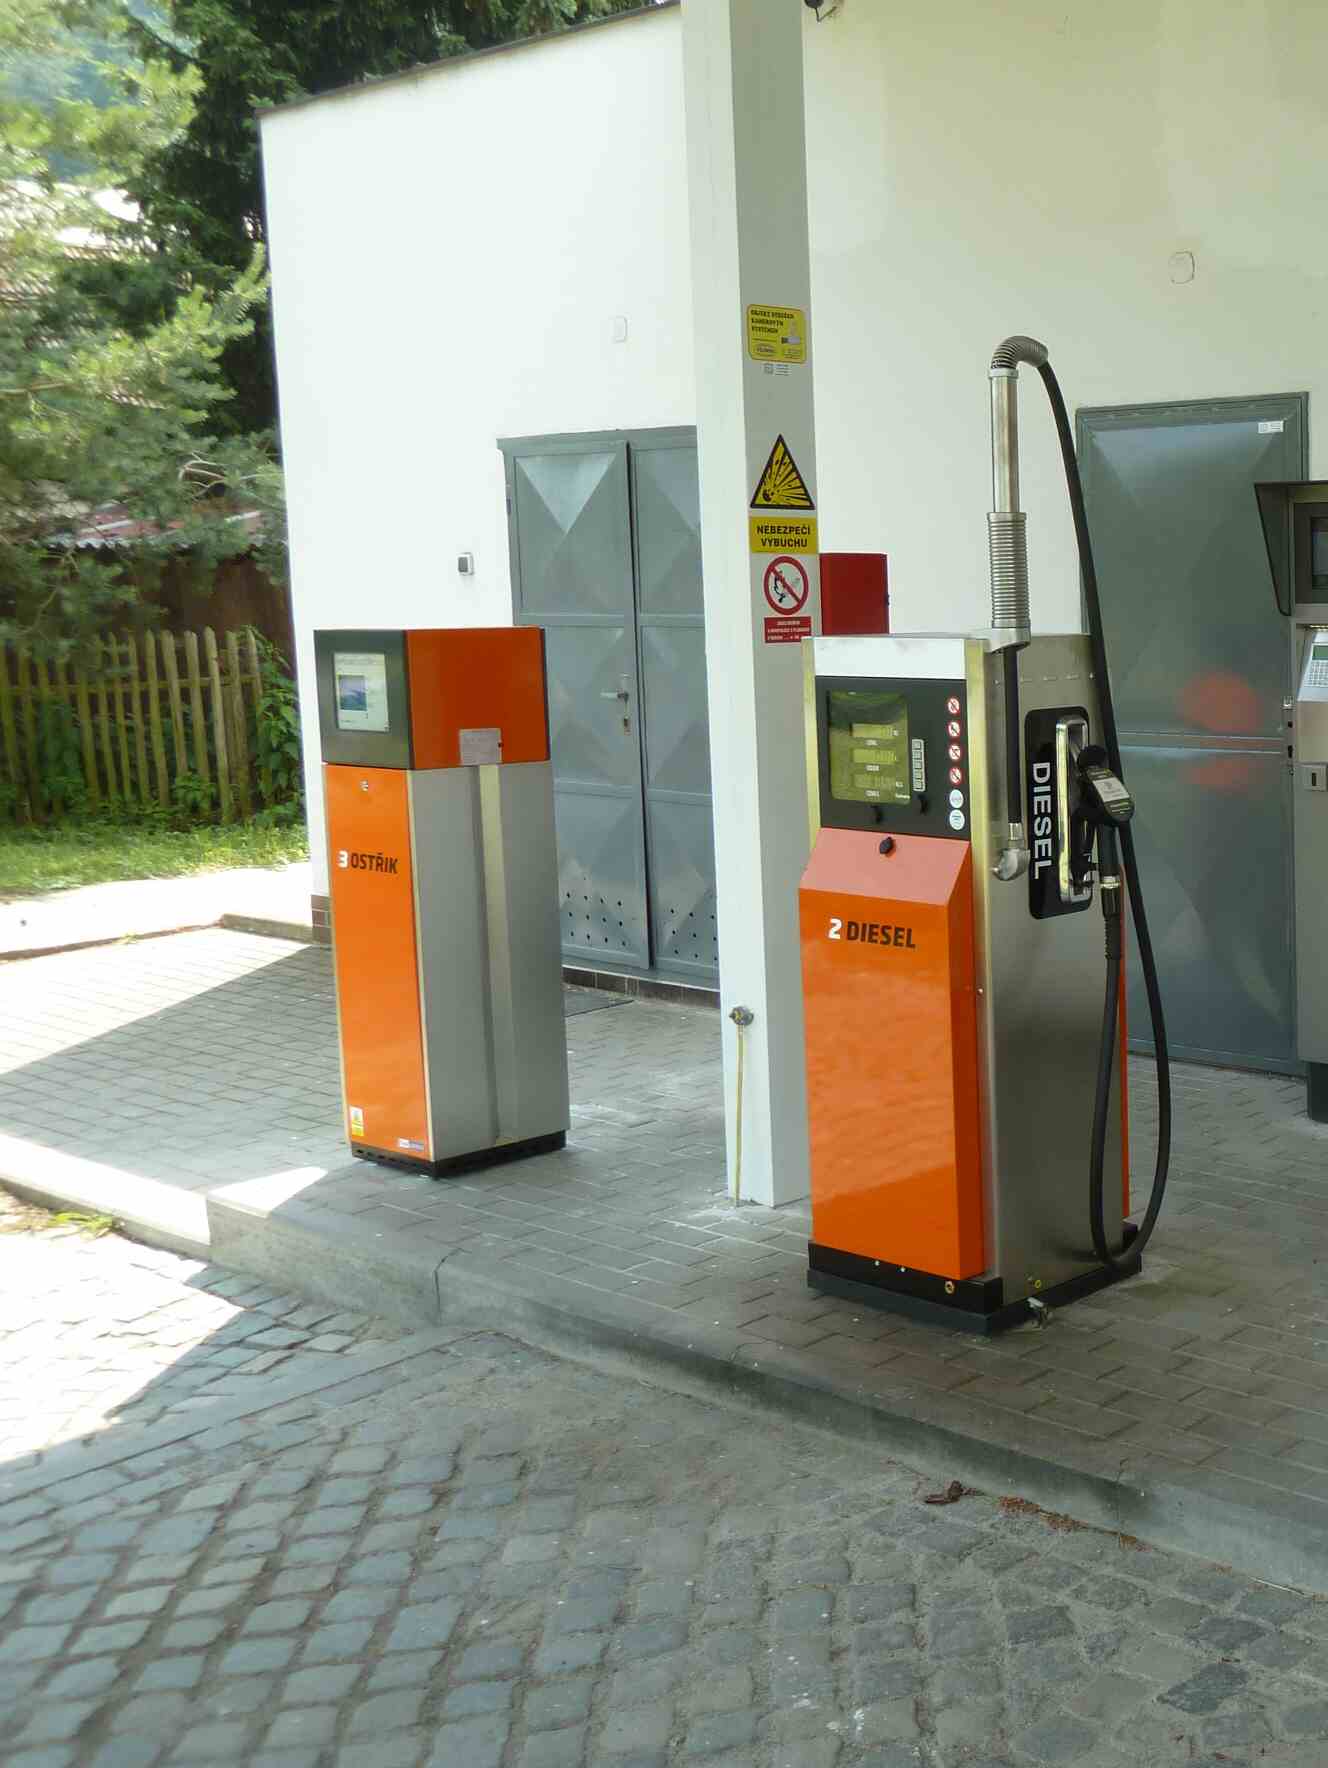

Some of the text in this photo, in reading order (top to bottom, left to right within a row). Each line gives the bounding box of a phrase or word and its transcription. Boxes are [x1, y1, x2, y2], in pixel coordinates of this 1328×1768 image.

[1033, 762, 1052, 880] DIESEL
[338, 850, 399, 874] 3 OSTŘIK
[828, 917, 916, 949] 2 DIESEL
